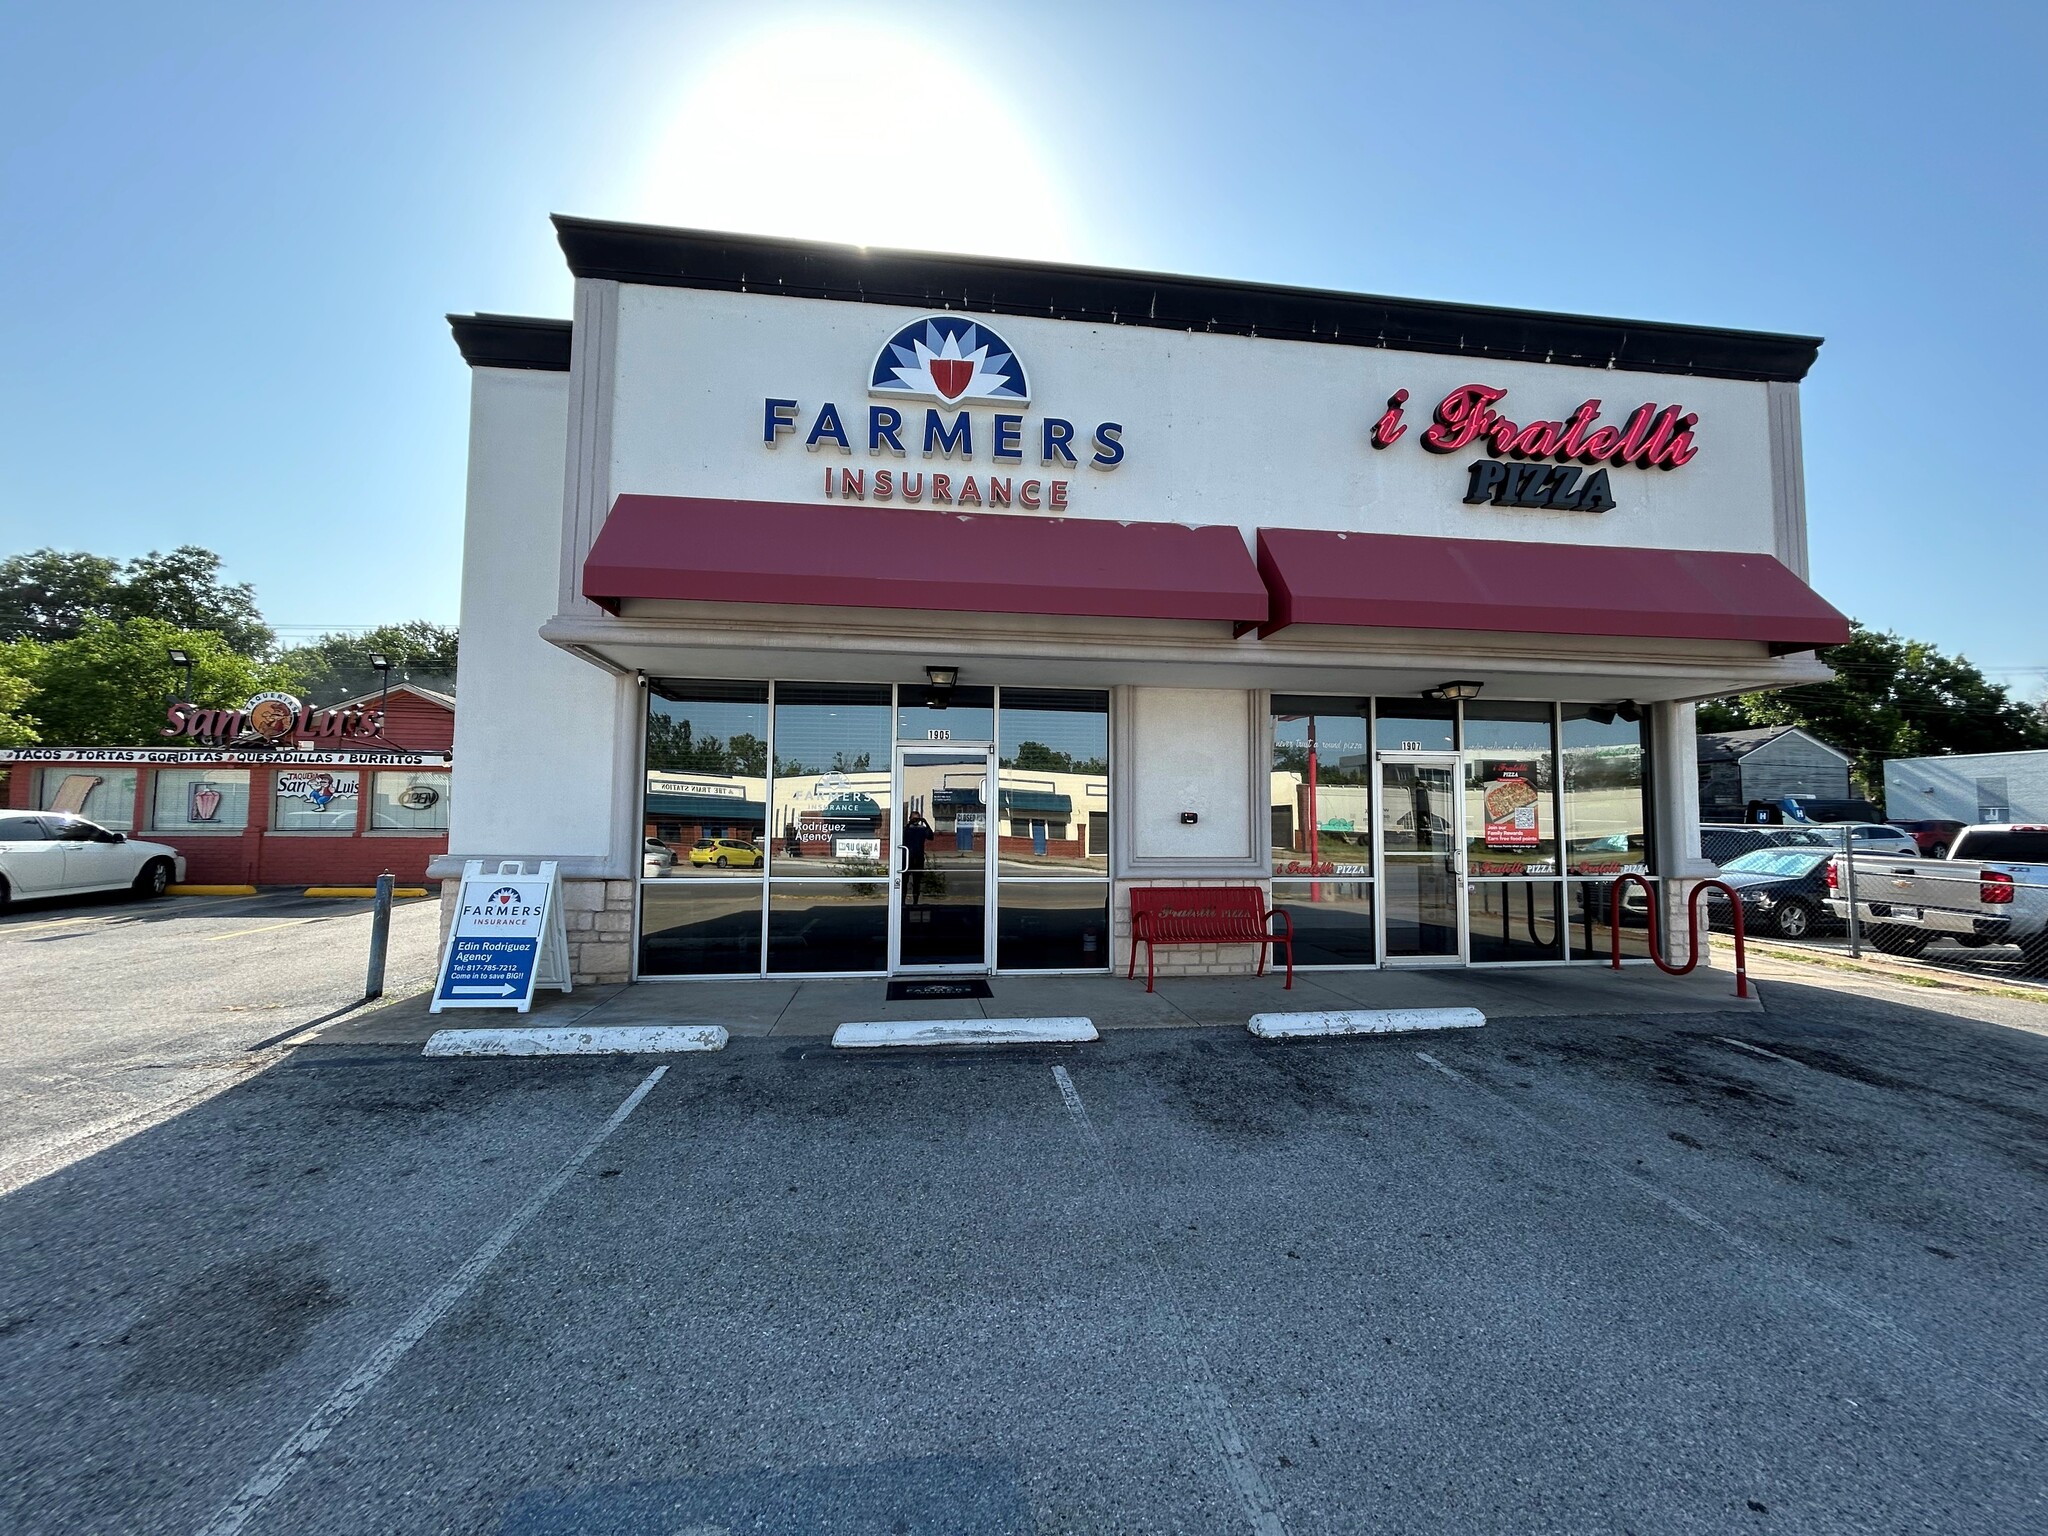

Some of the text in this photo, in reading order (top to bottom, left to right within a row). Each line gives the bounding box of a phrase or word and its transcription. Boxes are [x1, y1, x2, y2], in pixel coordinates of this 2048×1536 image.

[1370, 383, 1699, 471] i Fratelli
[762, 397, 1126, 471] FARMERS
[824, 467, 1069, 511] INSURANCE
[1462, 459, 1617, 513] PIZZA
[246, 693, 299, 711] TAQUERIAS
[161, 703, 380, 738] San Luis
[929, 730, 950, 740] 1905
[1322, 740, 1342, 749] round
[1343, 741, 1362, 752] pizza
[1402, 742, 1421, 750] 1907
[13, 750, 423, 764] TACOS TORTAS GORDITAS QUESADILLAS BURRITOS
[278, 778, 360, 794] San Luis
[795, 790, 871, 802] FARMERS
[795, 821, 846, 833] Rodriguez
[795, 831, 833, 843] Agency
[1285, 861, 1335, 875] Fratelli
[1336, 865, 1365, 874] PIZZA
[1480, 861, 1525, 875] Fratelli
[1526, 864, 1554, 873] PIZZA
[1578, 861, 1622, 874] Fratelli
[1623, 864, 1650, 873] PIZZA
[463, 905, 542, 916] FARMERS
[458, 942, 530, 952] Edin Rodriguez
[456, 952, 492, 963] Agency
[451, 972, 471, 980] Come
